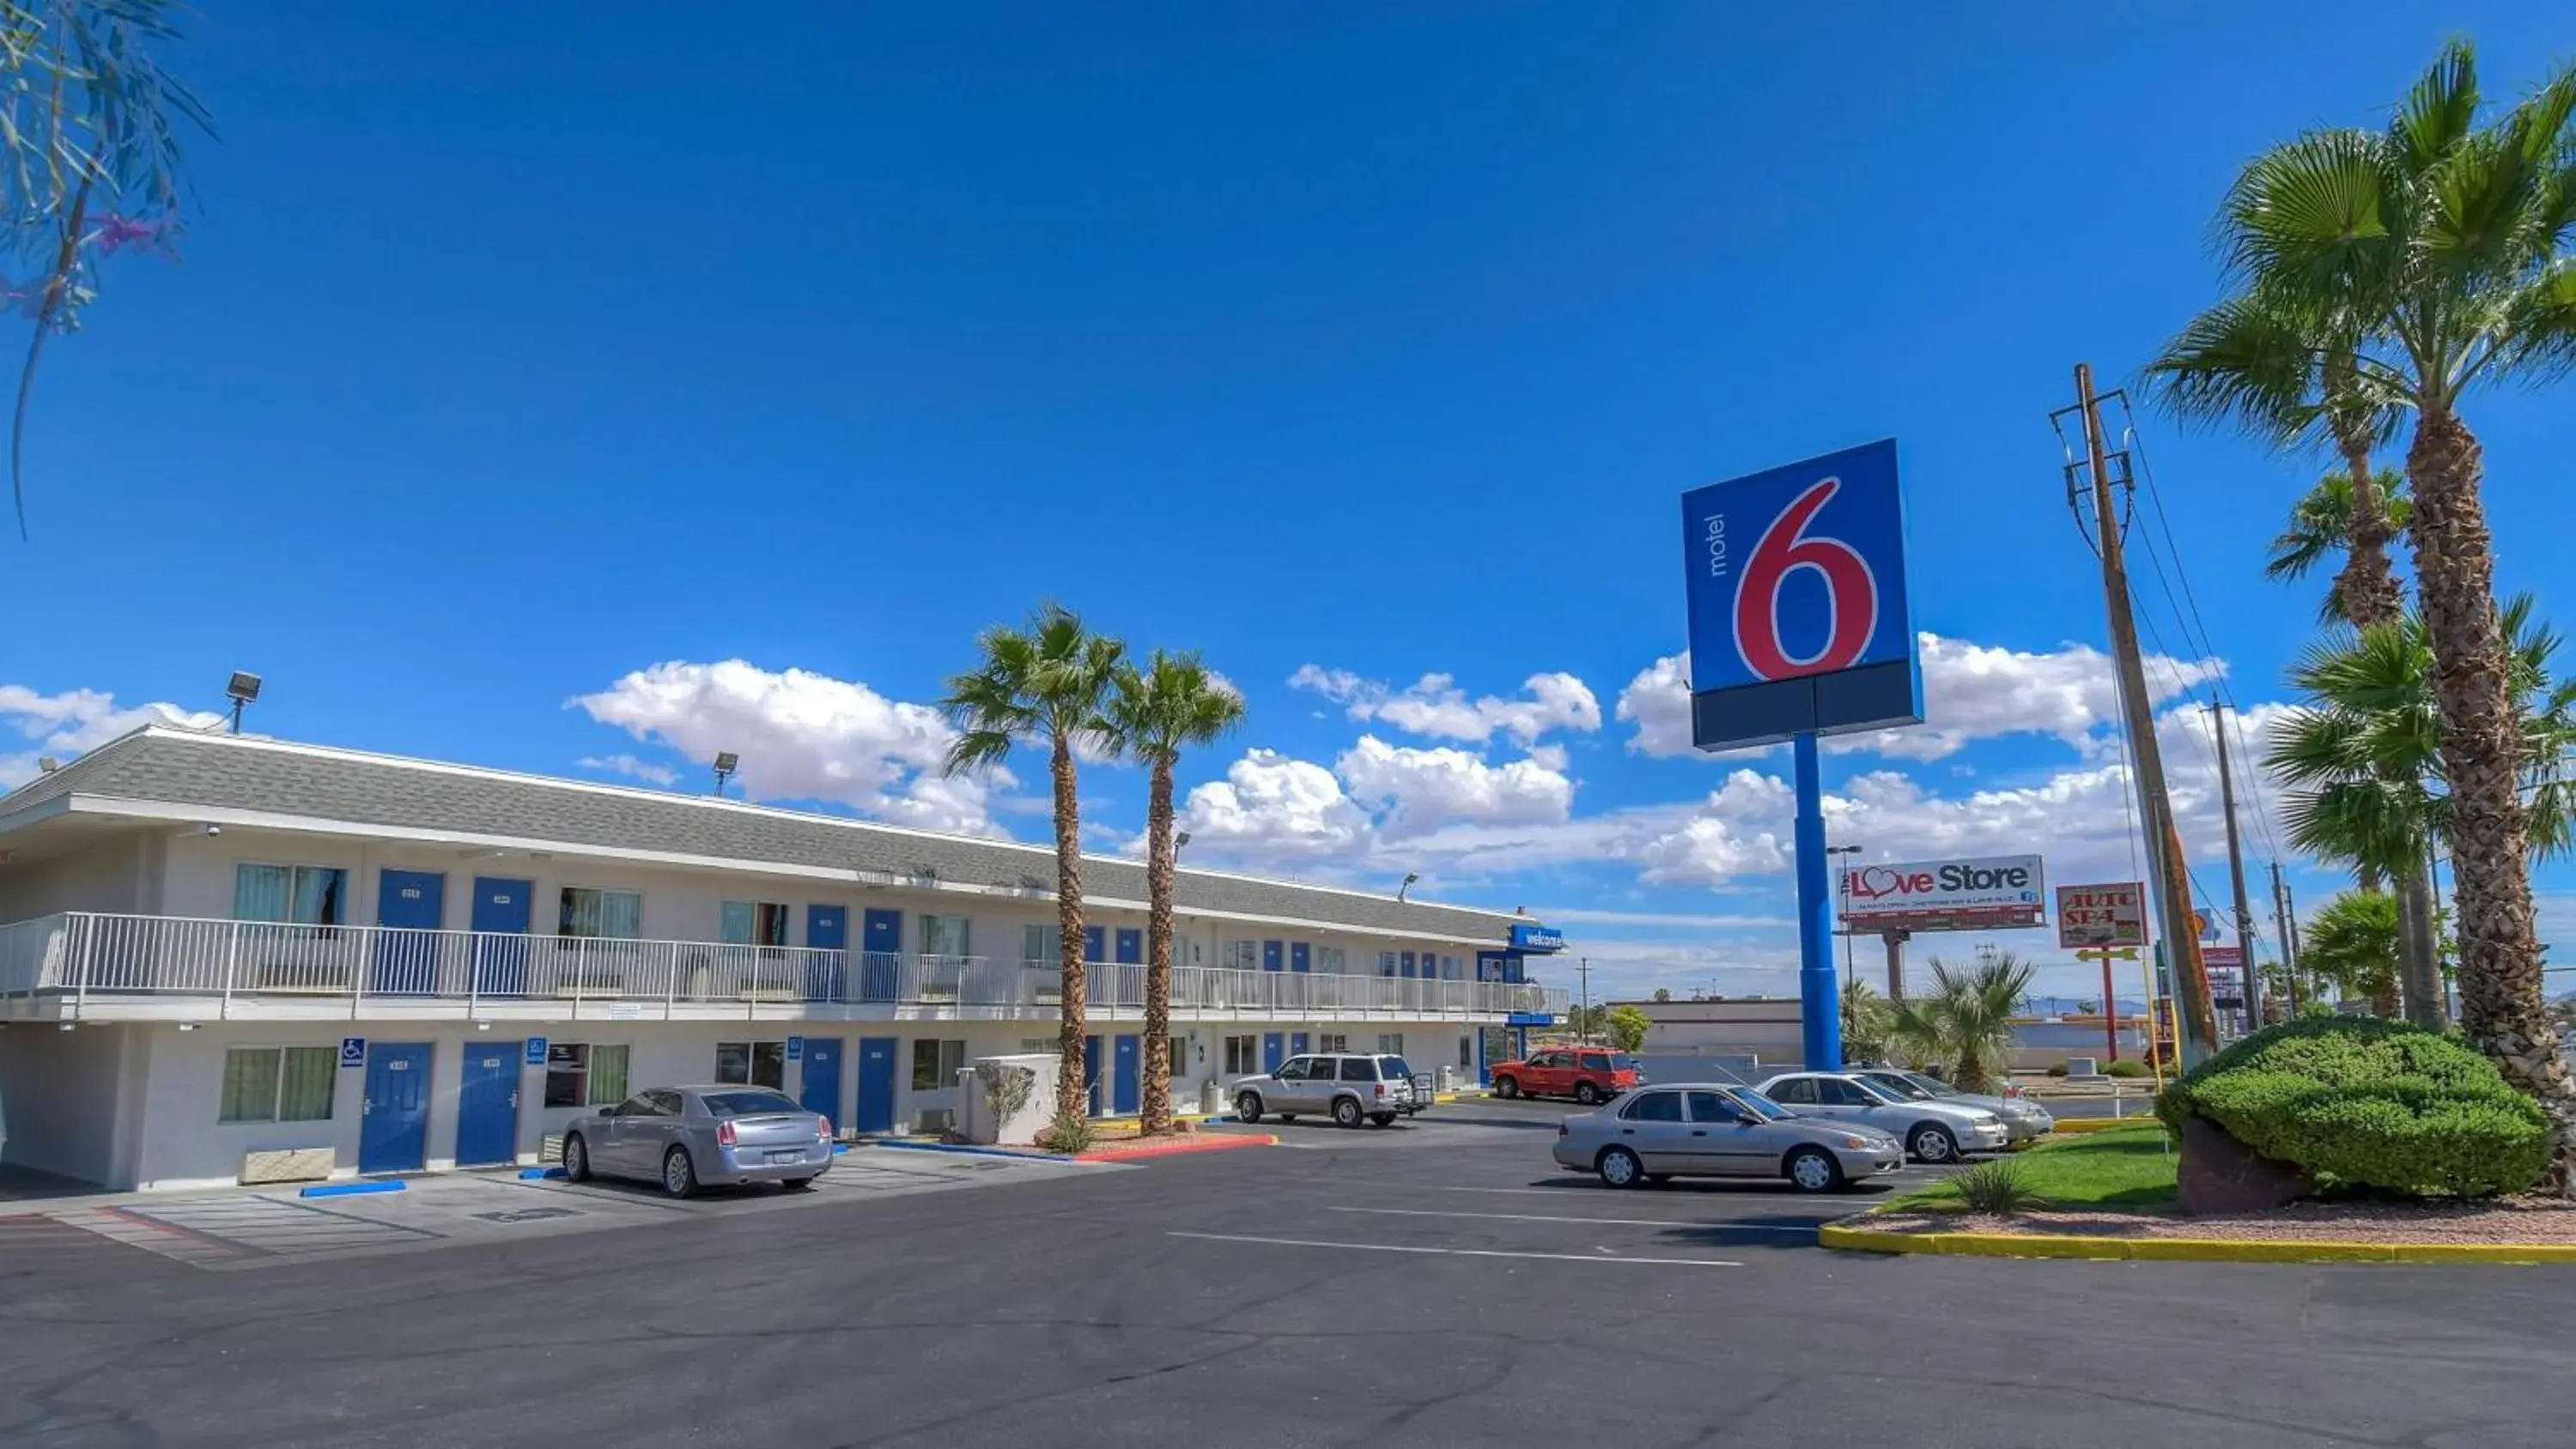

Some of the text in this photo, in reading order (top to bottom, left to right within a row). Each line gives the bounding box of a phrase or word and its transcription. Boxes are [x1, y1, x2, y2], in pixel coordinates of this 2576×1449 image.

[1703, 513, 1727, 577] motel
[1732, 476, 1879, 682] 6
[1939, 864, 2028, 891] Store
[1526, 930, 1563, 947] welcome
